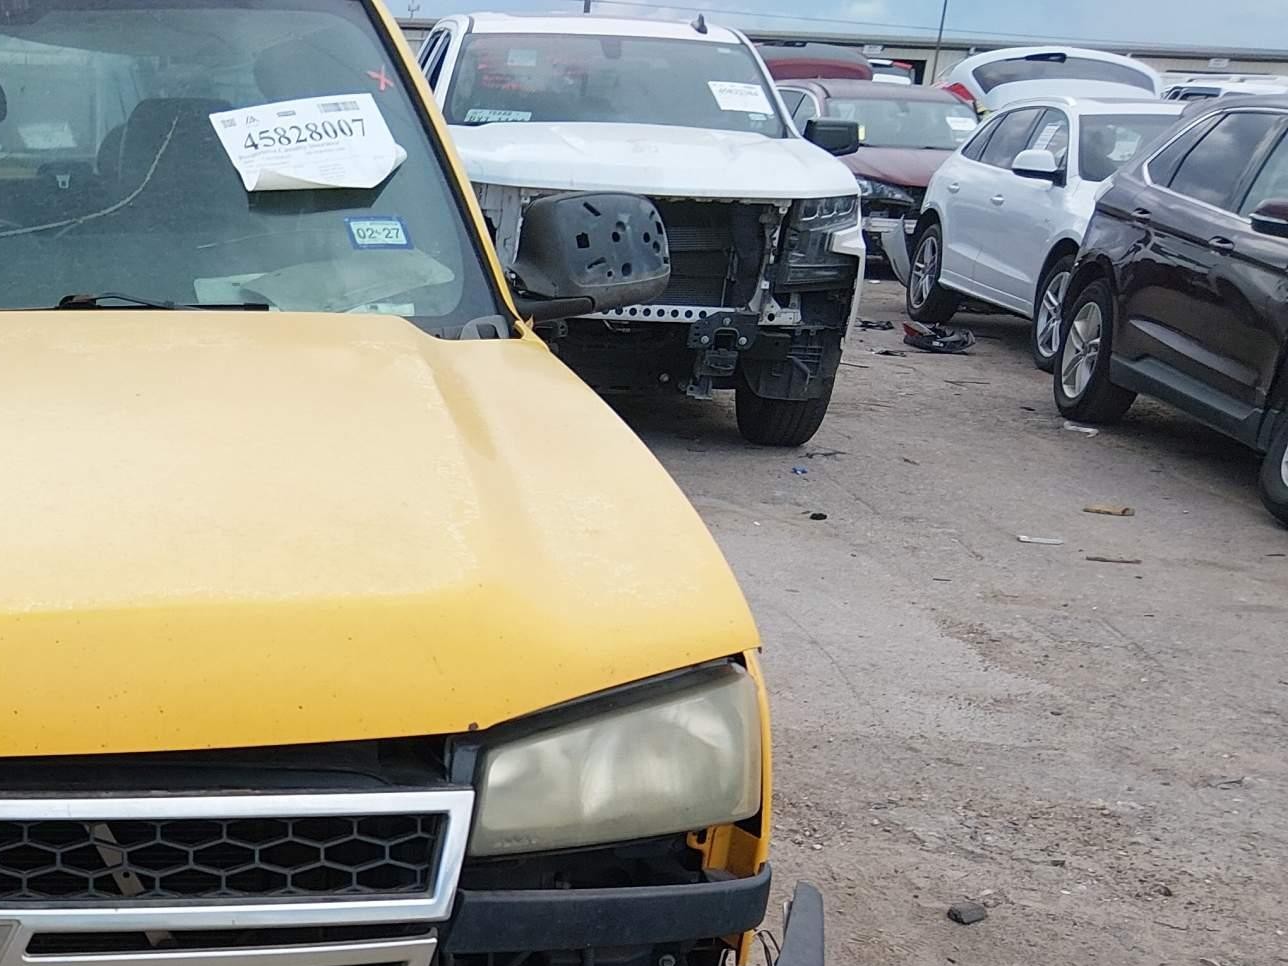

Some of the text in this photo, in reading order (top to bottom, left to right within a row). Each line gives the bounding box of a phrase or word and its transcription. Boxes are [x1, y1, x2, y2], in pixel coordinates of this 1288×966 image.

[244, 118, 366, 150] 45828007
[356, 227, 400, 239] 02 27
